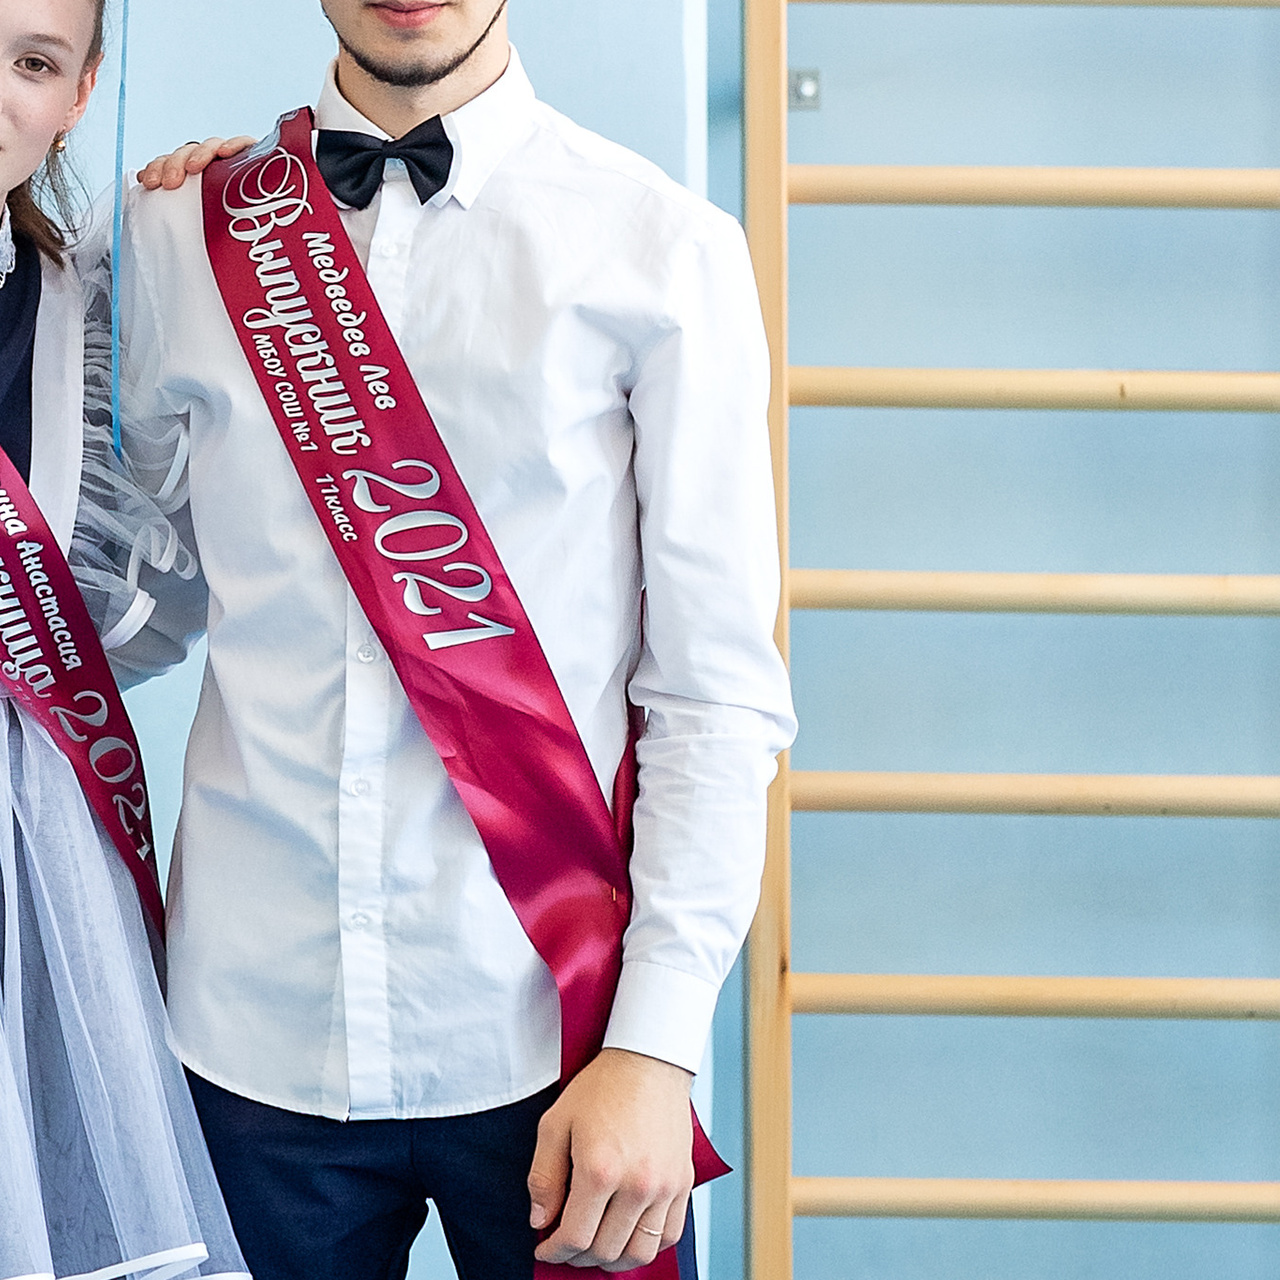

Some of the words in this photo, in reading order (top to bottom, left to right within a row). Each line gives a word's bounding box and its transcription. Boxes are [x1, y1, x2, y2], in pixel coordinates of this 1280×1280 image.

[252, 333, 287, 377] МБОУ
[274, 381, 304, 418] СОШ
[302, 232, 371, 357] Медведев
[359, 365, 397, 410] Лев
[222, 146, 371, 456] Выпускник
[342, 459, 516, 651] 2021
[16, 540, 83, 671] Анастасия
